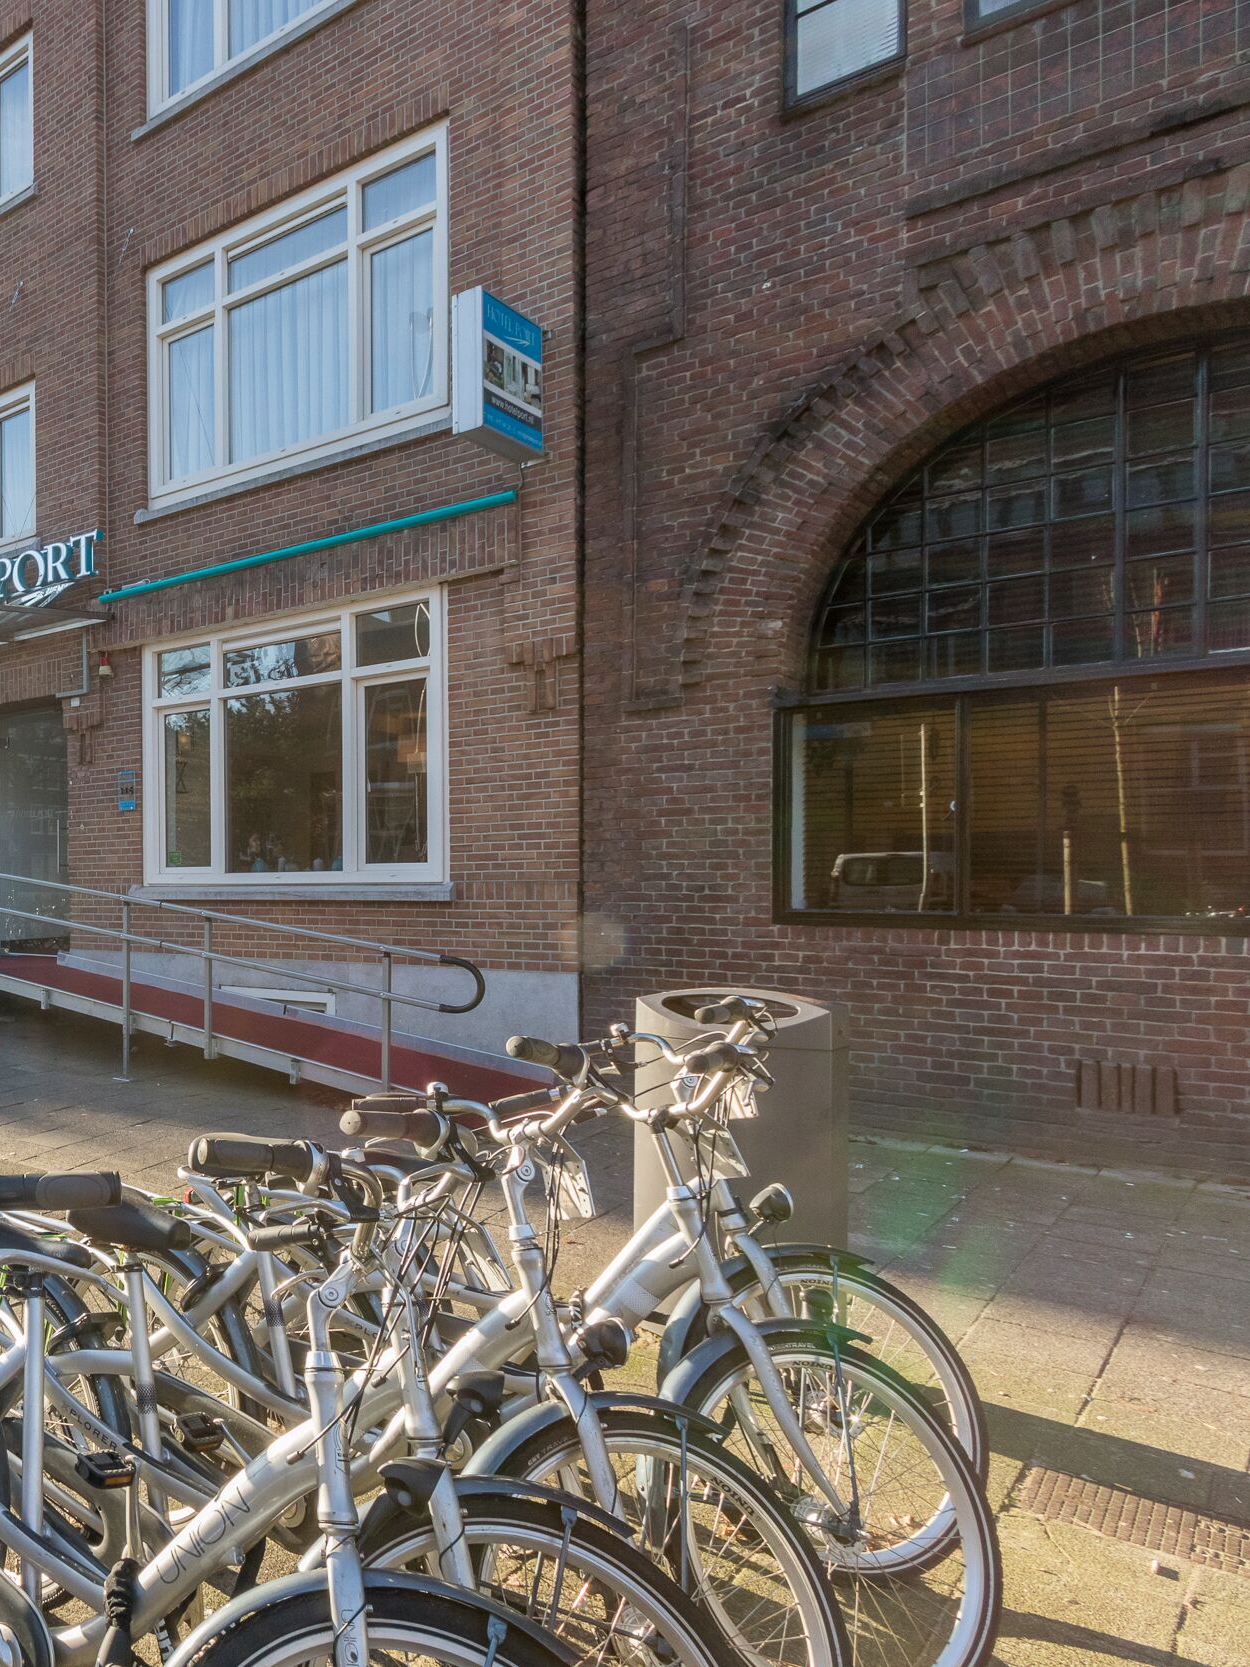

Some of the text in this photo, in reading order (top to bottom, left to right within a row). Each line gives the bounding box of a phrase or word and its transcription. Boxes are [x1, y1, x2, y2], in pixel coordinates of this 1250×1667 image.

[792, 1360, 833, 1371] UNION
[710, 1477, 755, 1517] UNION
[155, 1486, 251, 1586] UNION
